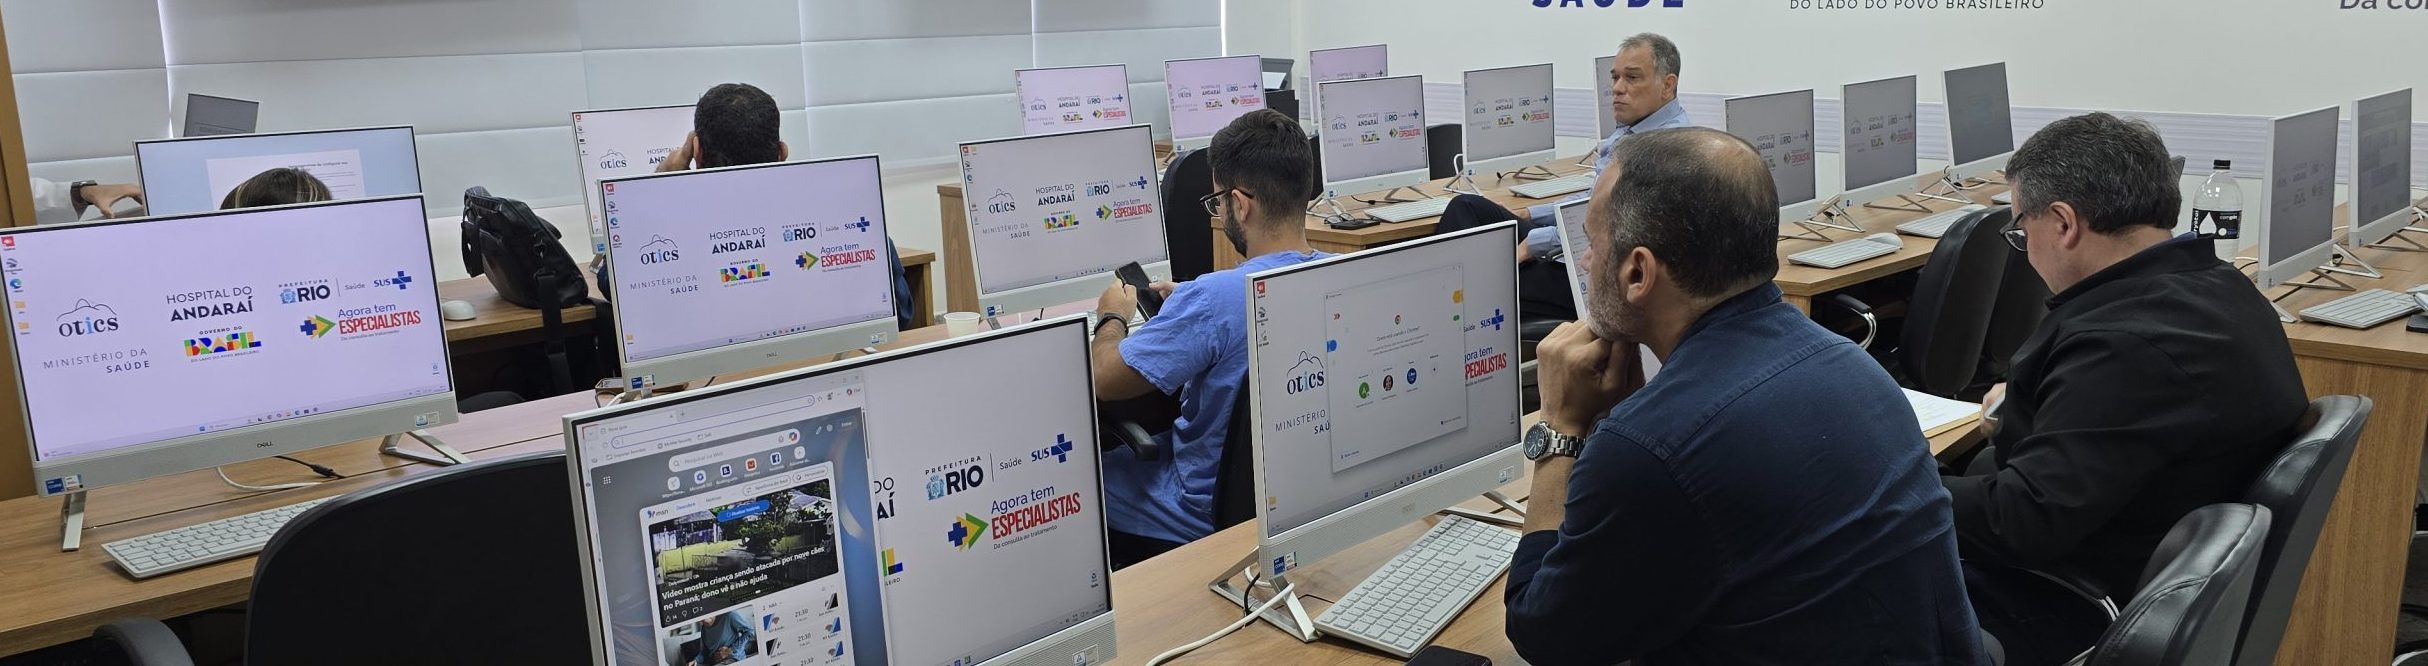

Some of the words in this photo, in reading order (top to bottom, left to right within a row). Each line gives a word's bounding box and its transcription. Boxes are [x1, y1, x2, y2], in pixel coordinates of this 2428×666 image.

[1894, 0, 1938, 9] POVO
[1946, 0, 2044, 9] BRASILEIRO
[2387, 0, 2428, 9] co
[600, 159, 627, 169] otics
[1035, 186, 1064, 195] HOSPITAL
[1038, 190, 1075, 206] ANDARAÍ
[1094, 184, 1110, 196] RIO
[988, 201, 1016, 214] otics
[709, 228, 751, 240] HOSPITAL
[752, 226, 766, 235] DO
[794, 226, 816, 241] RIO
[1010, 231, 1030, 239] SAÚDE
[712, 234, 766, 254] ANDARAÍ
[820, 244, 843, 255] Agora
[844, 243, 860, 251] tem
[640, 249, 679, 265] otics
[821, 249, 876, 267] ESPECIALISTAS
[344, 282, 366, 290] Saúde
[374, 279, 391, 288] SUS
[630, 277, 682, 290] MINISTÉRIO
[670, 284, 699, 294] SAÚDE
[166, 288, 230, 305] HOSPITAL
[232, 286, 252, 297] DO
[297, 285, 331, 302] RIO
[170, 296, 254, 322] ANDARAÍ
[338, 305, 372, 319] Agora
[374, 303, 396, 313] tem
[59, 316, 119, 337] otics
[339, 310, 422, 334] ESPECIALISTAS
[1480, 318, 1491, 328] SUS
[184, 331, 262, 357] BRASIL
[1479, 346, 1493, 357] tem
[43, 351, 124, 369] MINISTÉRIO
[130, 348, 148, 357] DA
[106, 360, 150, 373] SAÚDE
[1465, 352, 1507, 381] PECIALISTAS
[1286, 370, 1325, 395] otics
[1275, 409, 1326, 432] MINISTÉRIO
[1314, 420, 1331, 435] SAÚ
[1031, 447, 1049, 462] SUS
[925, 455, 982, 475] PREFEITURA
[999, 457, 1022, 470] Saúde
[945, 465, 984, 495] RIO
[991, 494, 1028, 514] Agora
[1030, 486, 1055, 502] tem
[655, 508, 669, 516] msn
[991, 492, 1081, 540] ESPECIALISTAS
[993, 542, 1001, 550] Da
[1001, 536, 1023, 547] consulta
[1030, 525, 1058, 538] tratamento
[684, 581, 709, 594] mostra
[709, 573, 734, 586] criança
[734, 567, 754, 579] sendo
[755, 559, 781, 572] atacada
[781, 555, 793, 566] por
[794, 550, 810, 560] nove
[663, 603, 673, 611] no
[701, 589, 720, 599] dono
[720, 584, 729, 592] vê
[735, 580, 748, 589] não
[749, 573, 768, 586] ajuda
